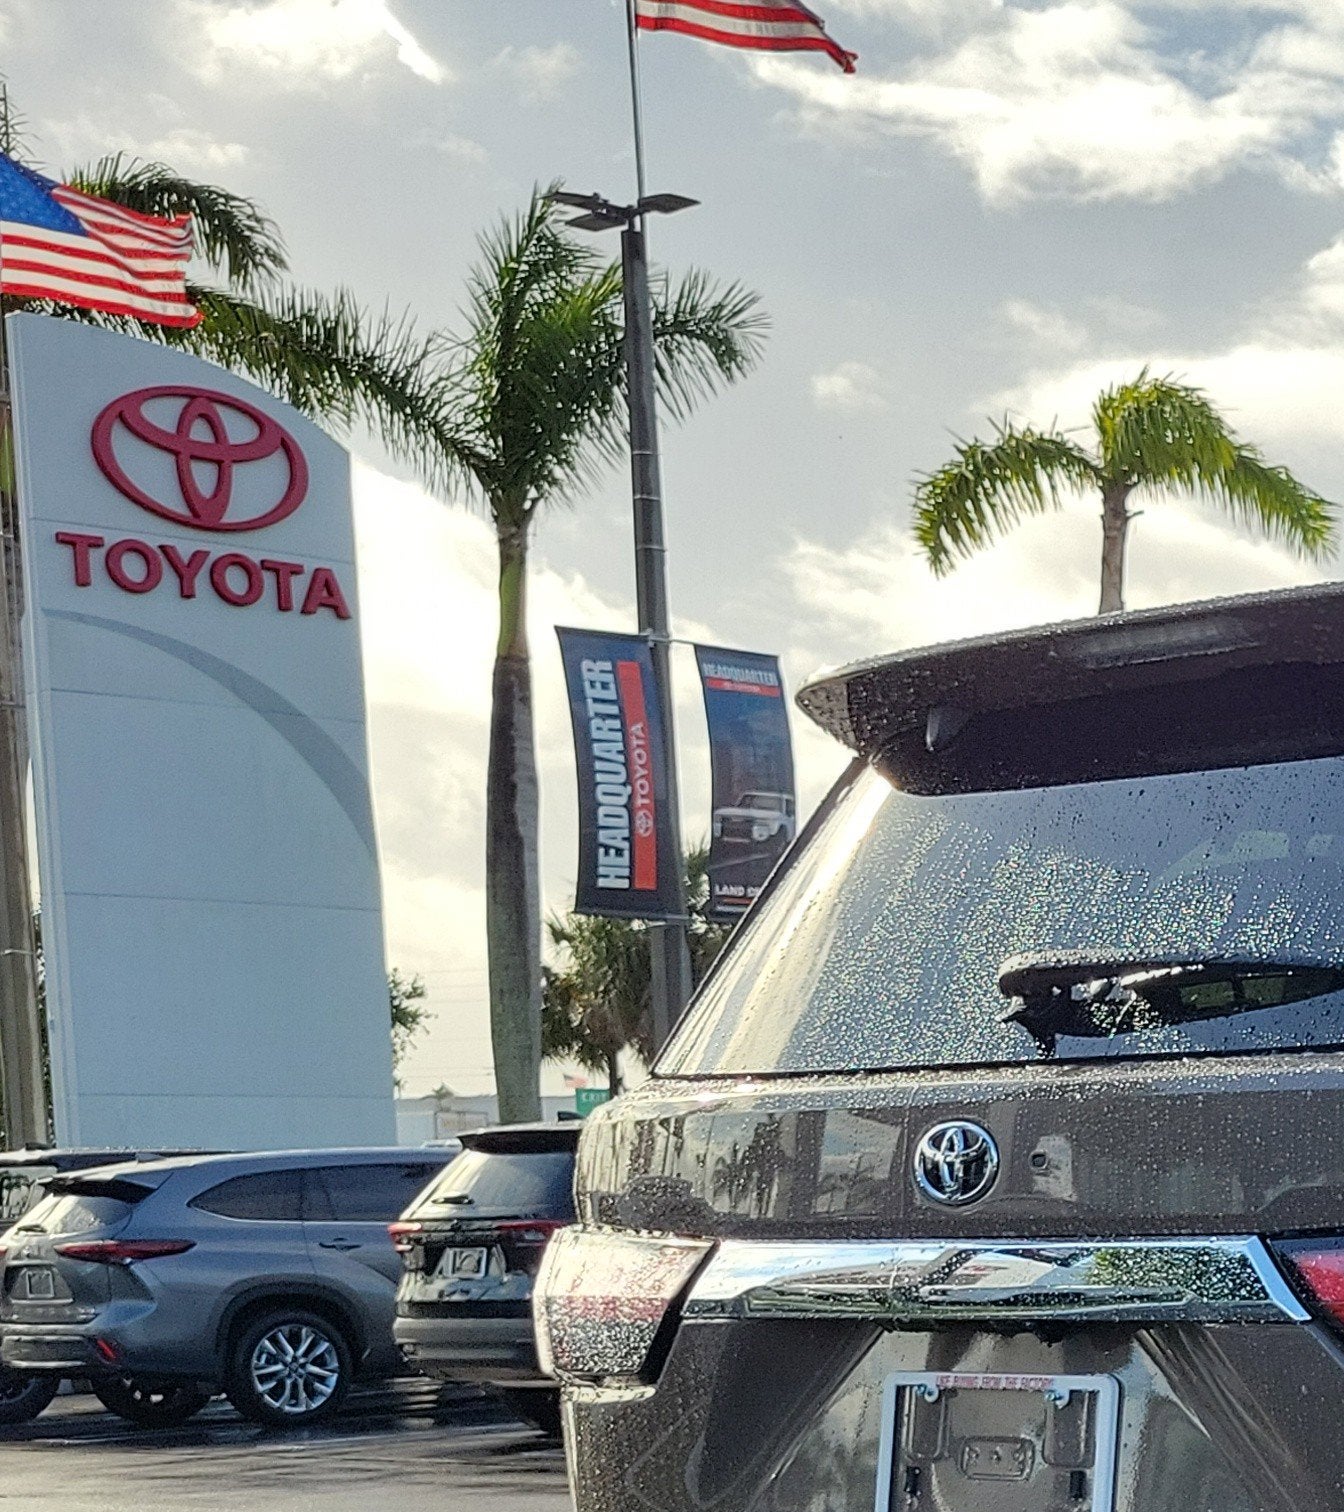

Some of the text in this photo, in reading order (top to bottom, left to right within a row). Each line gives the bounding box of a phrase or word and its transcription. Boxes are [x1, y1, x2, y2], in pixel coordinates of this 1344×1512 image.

[55, 531, 352, 620] TOYOTA
[580, 658, 633, 890] HEADQUARTER
[630, 721, 651, 807] TOYOTA
[713, 884, 746, 897] LAND
